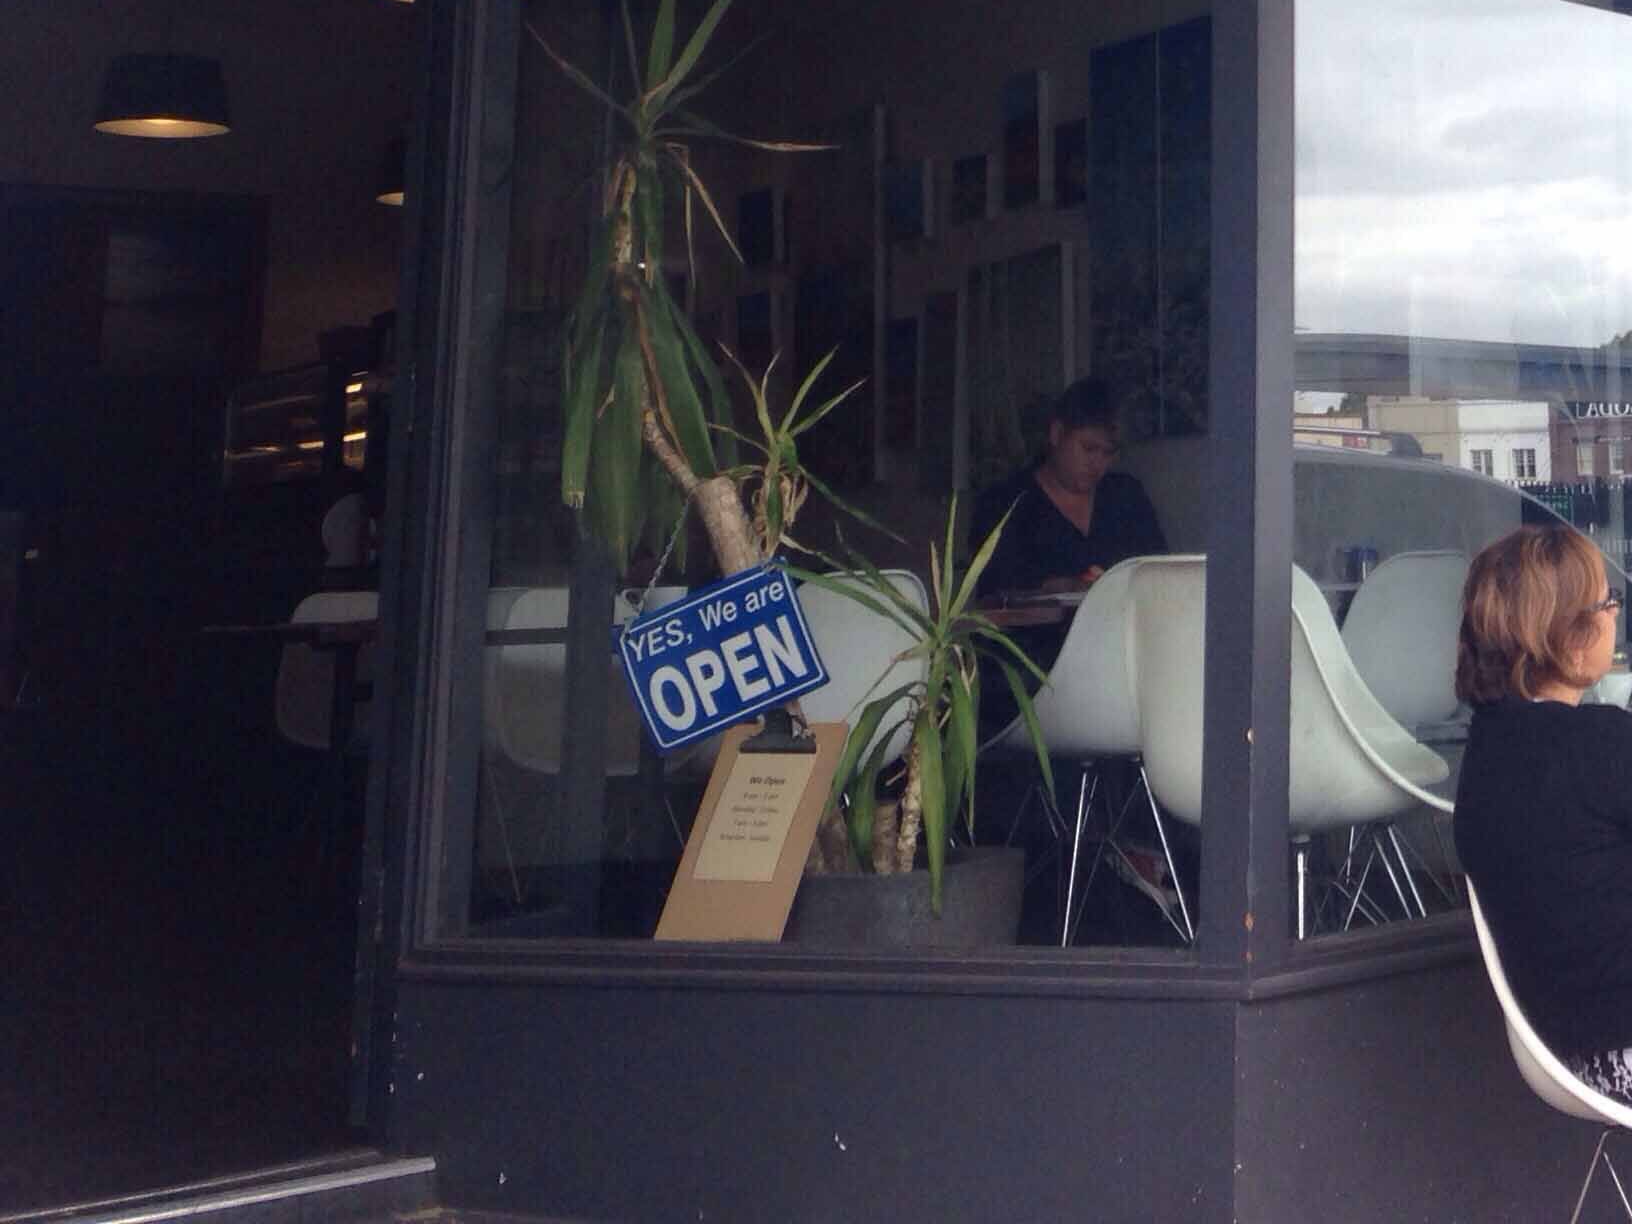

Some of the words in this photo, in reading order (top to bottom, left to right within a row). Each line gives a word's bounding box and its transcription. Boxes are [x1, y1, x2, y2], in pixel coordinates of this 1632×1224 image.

[627, 619, 693, 663] YES,
[698, 600, 738, 632] We
[743, 580, 785, 614] are
[650, 615, 808, 732] OPEN
